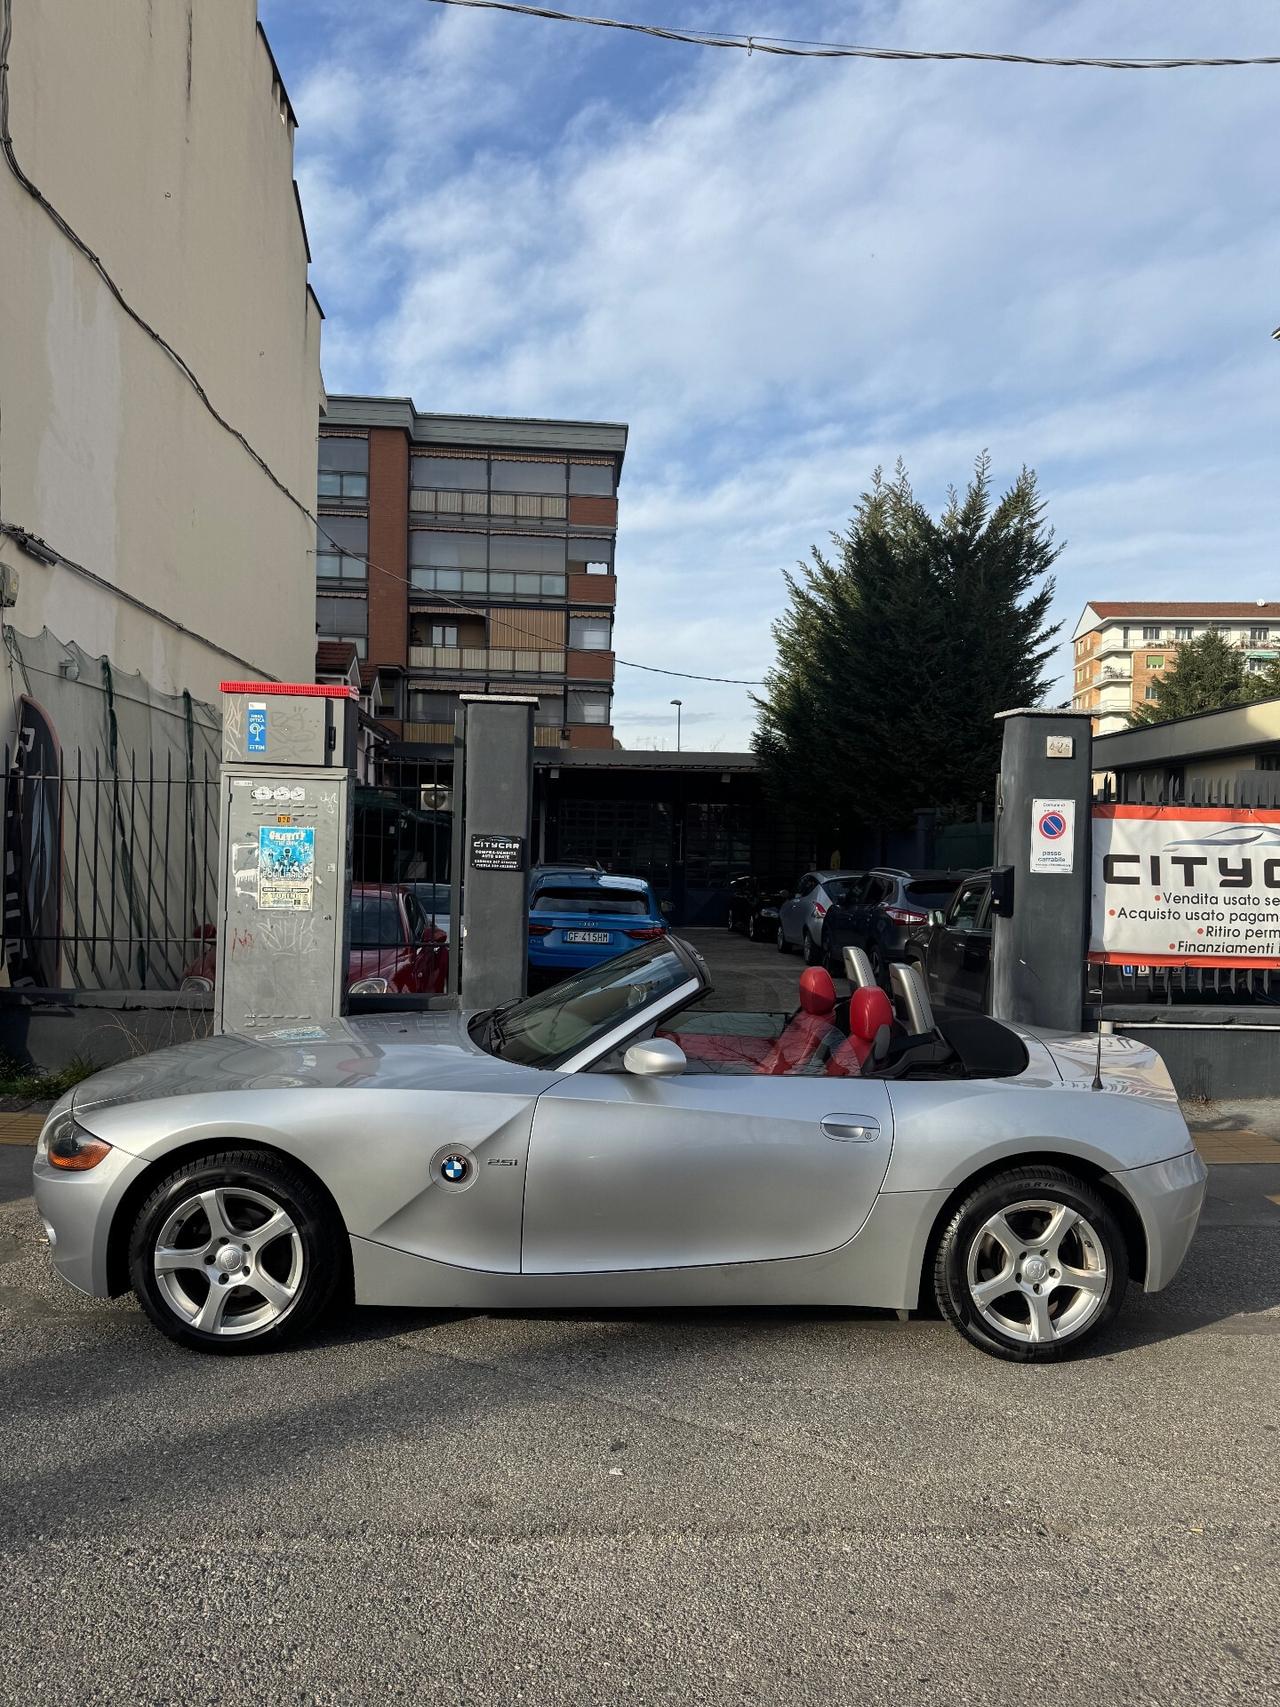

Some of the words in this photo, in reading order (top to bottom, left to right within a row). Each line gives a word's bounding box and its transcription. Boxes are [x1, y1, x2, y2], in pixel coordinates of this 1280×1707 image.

[473, 841, 520, 849] CITYCAR
[1163, 892, 1218, 905] Vendita
[1223, 894, 1260, 906] usato
[1117, 907, 1181, 921] Acquisto
[1185, 909, 1224, 921] usato
[1206, 925, 1241, 937] Ritiro
[1178, 941, 1275, 954] Finanziamenti
